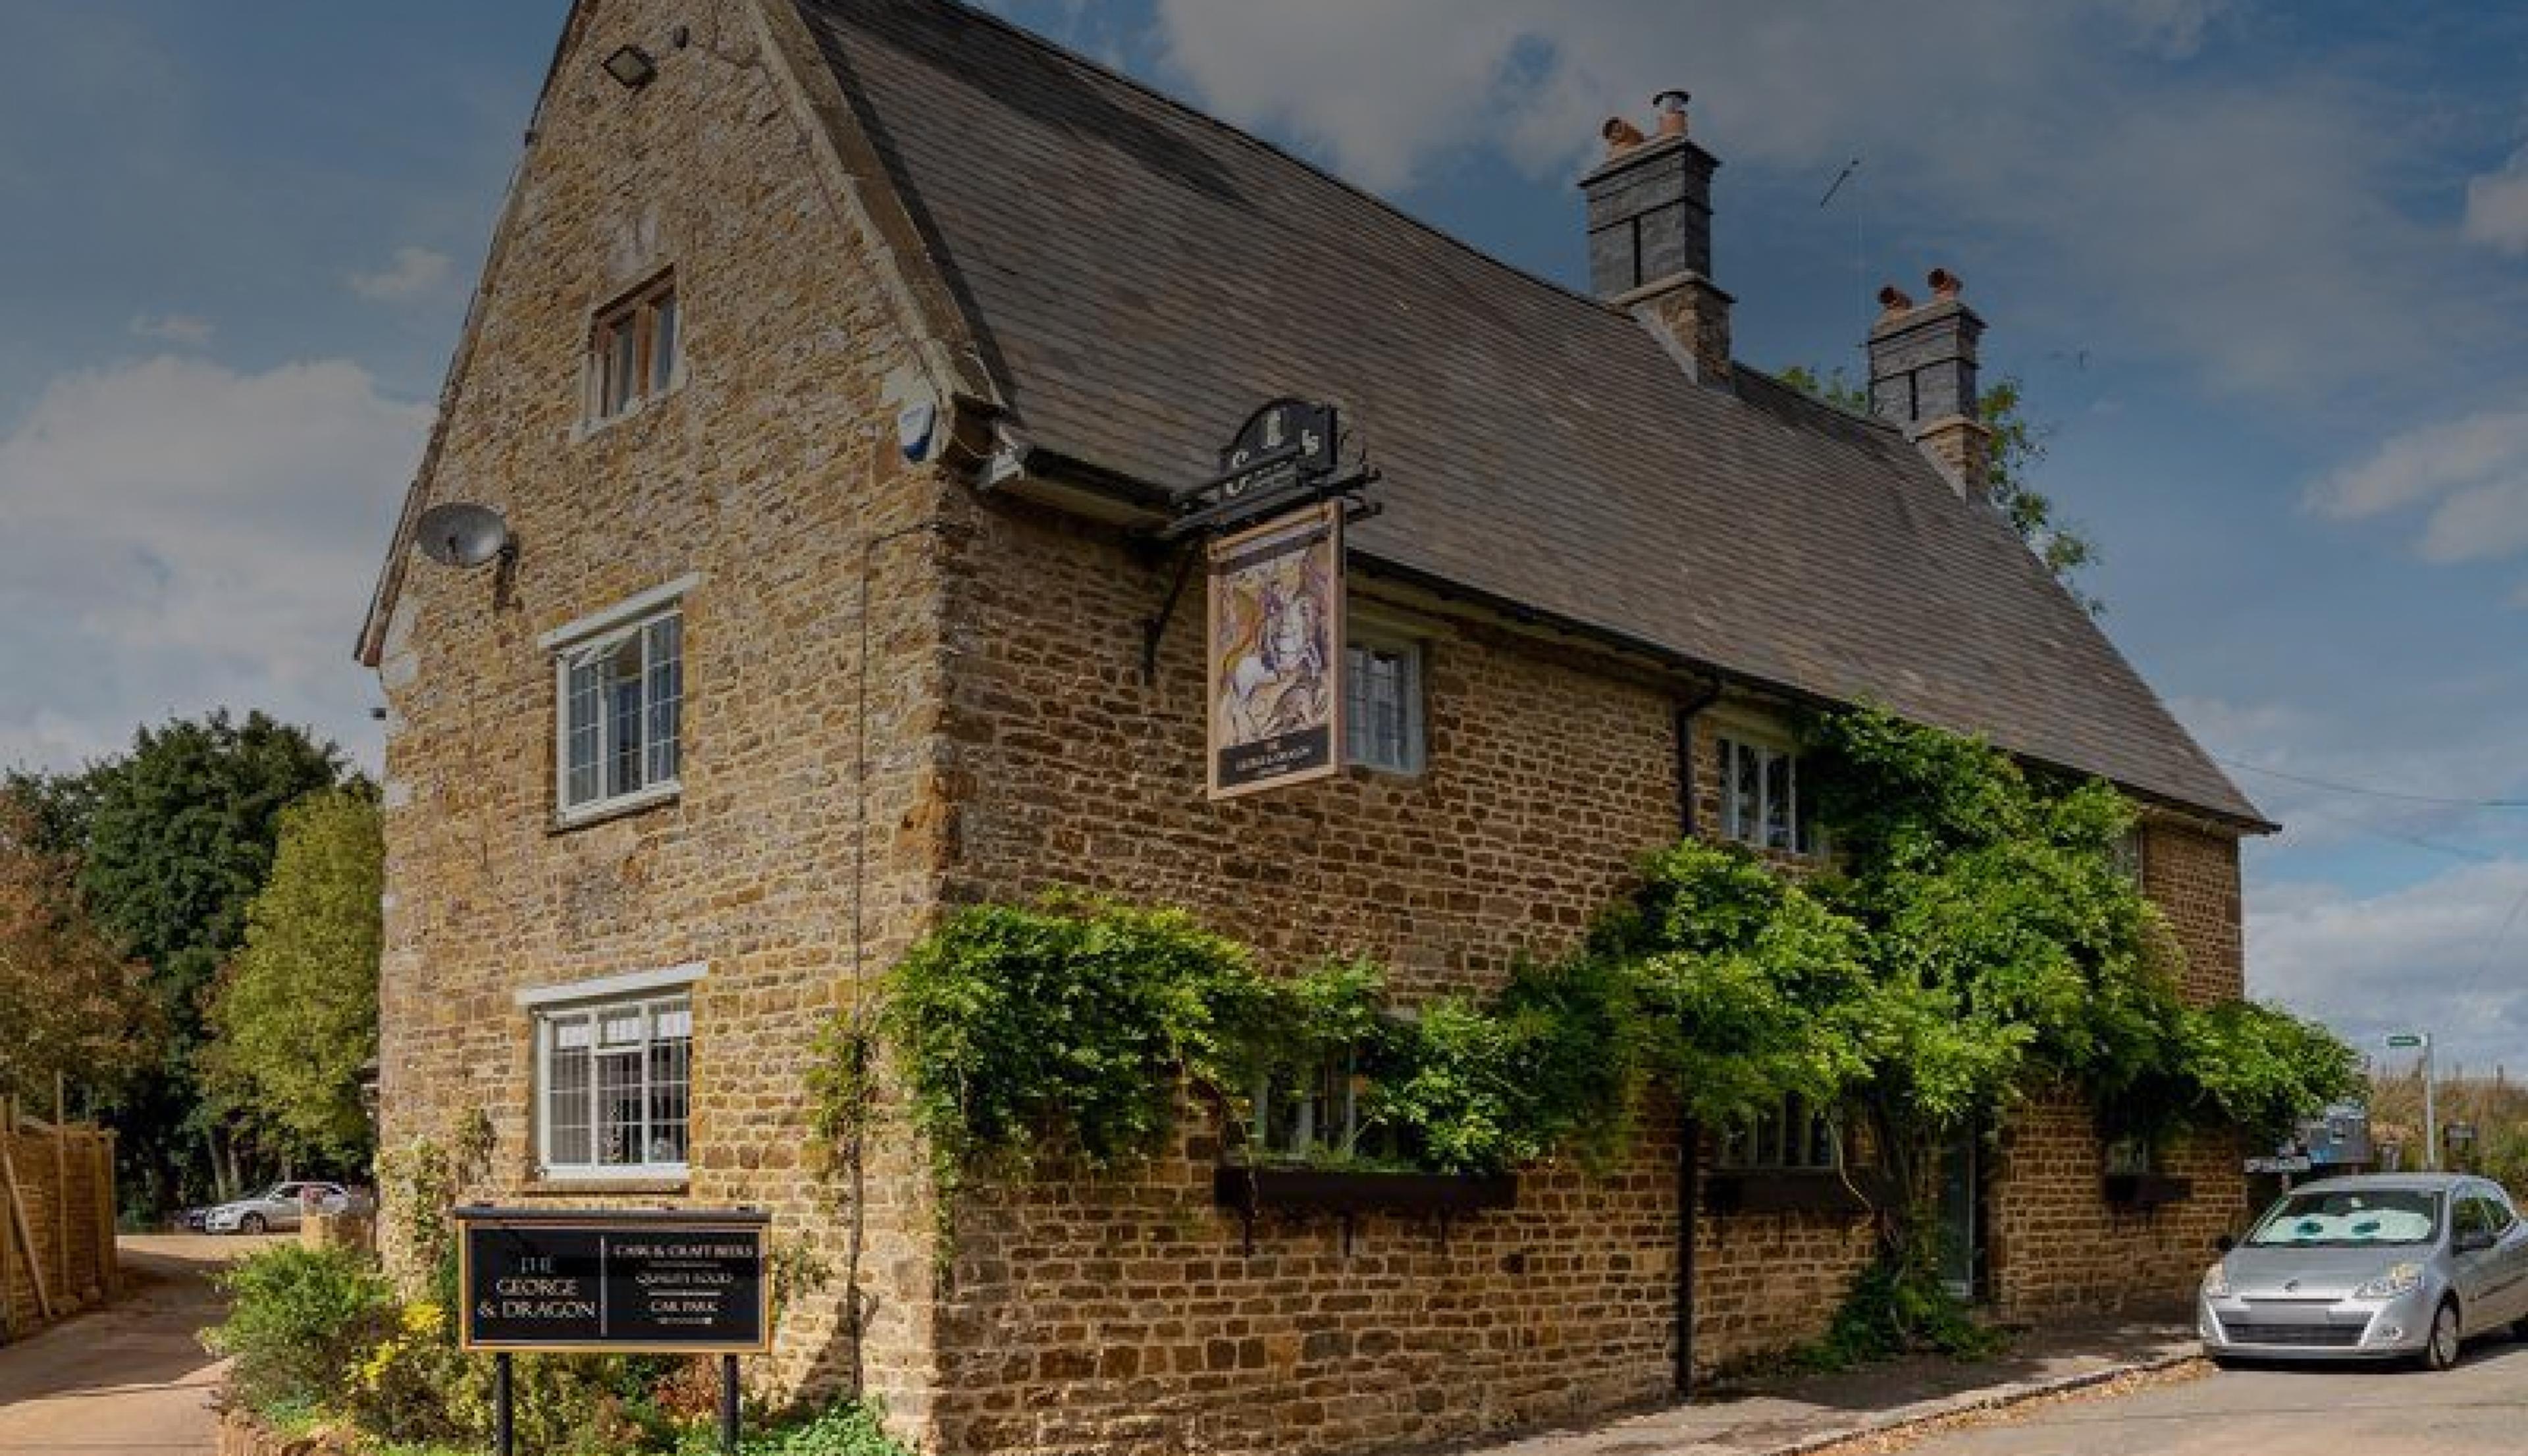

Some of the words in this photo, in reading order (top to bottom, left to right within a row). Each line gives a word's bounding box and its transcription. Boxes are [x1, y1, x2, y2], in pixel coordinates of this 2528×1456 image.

[496, 1278, 580, 1296] GEORGE
[479, 1301, 495, 1318] &
[502, 1301, 596, 1318] DRAGON
